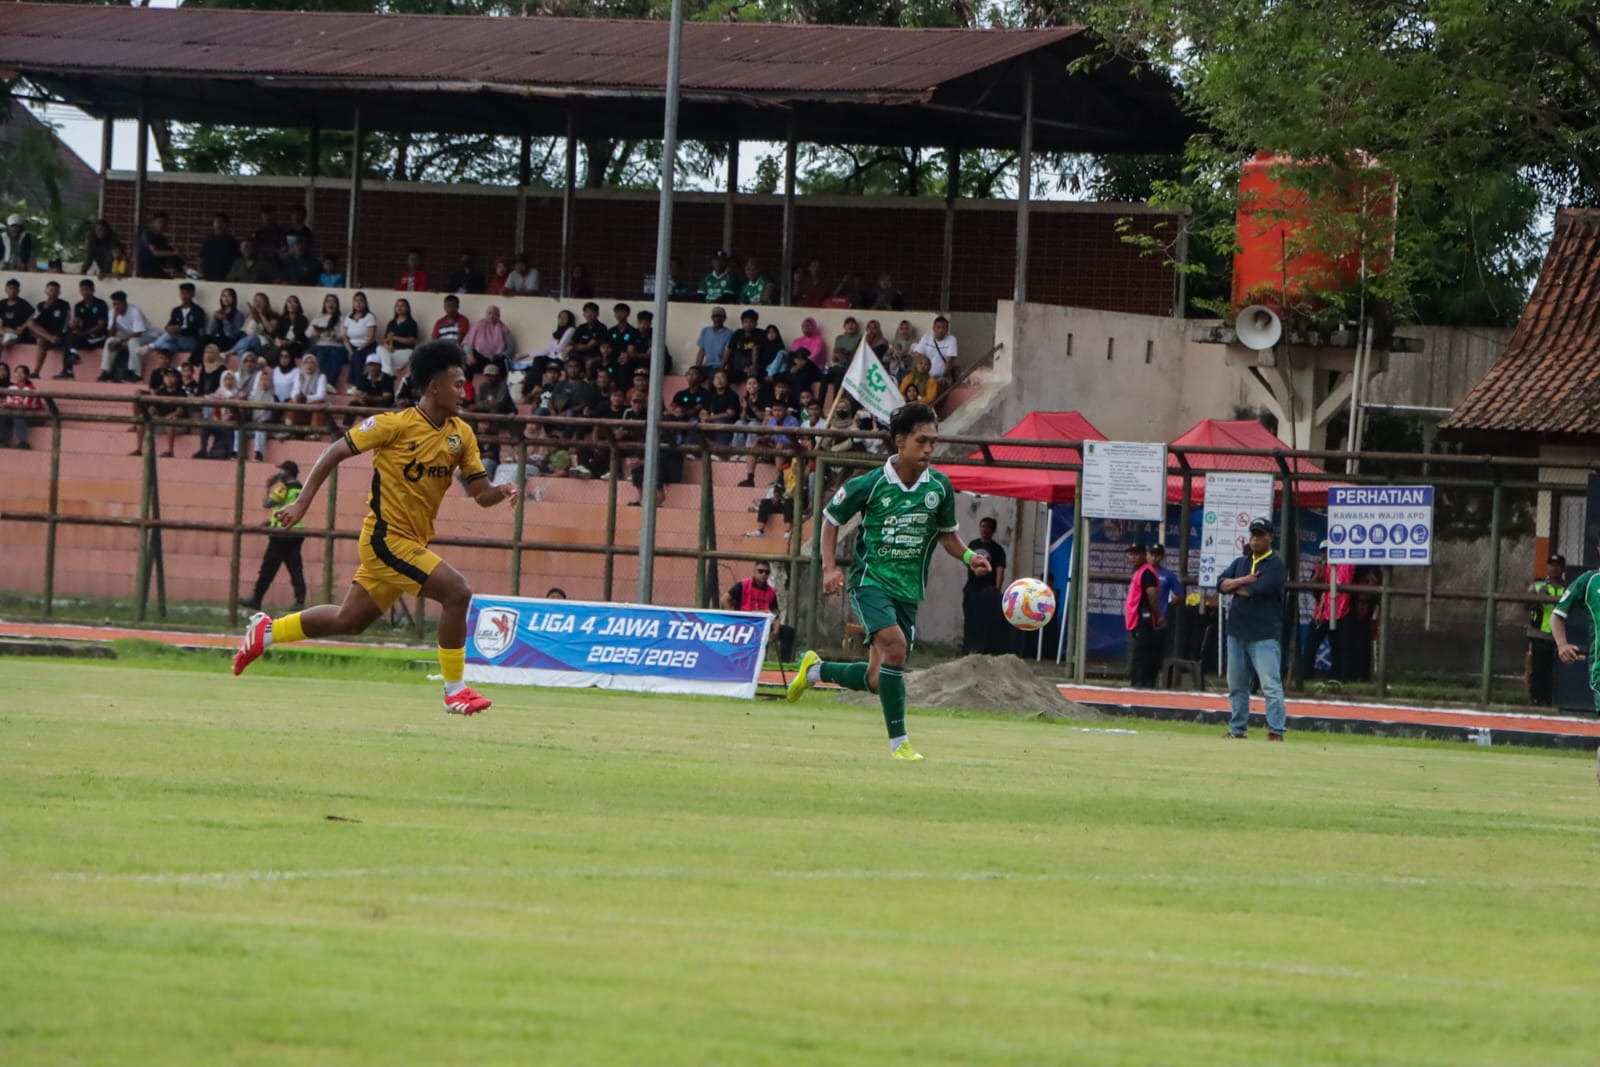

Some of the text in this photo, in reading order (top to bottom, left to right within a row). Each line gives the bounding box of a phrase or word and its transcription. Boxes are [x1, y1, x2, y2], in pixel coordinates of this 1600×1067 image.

[1336, 489, 1424, 504] PERHATIAN
[1333, 511, 1425, 520] KAWASAN WAJIB APD
[527, 612, 755, 645] LIGA 4 JAWA TENGAH
[587, 646, 699, 669] 2025/2026
